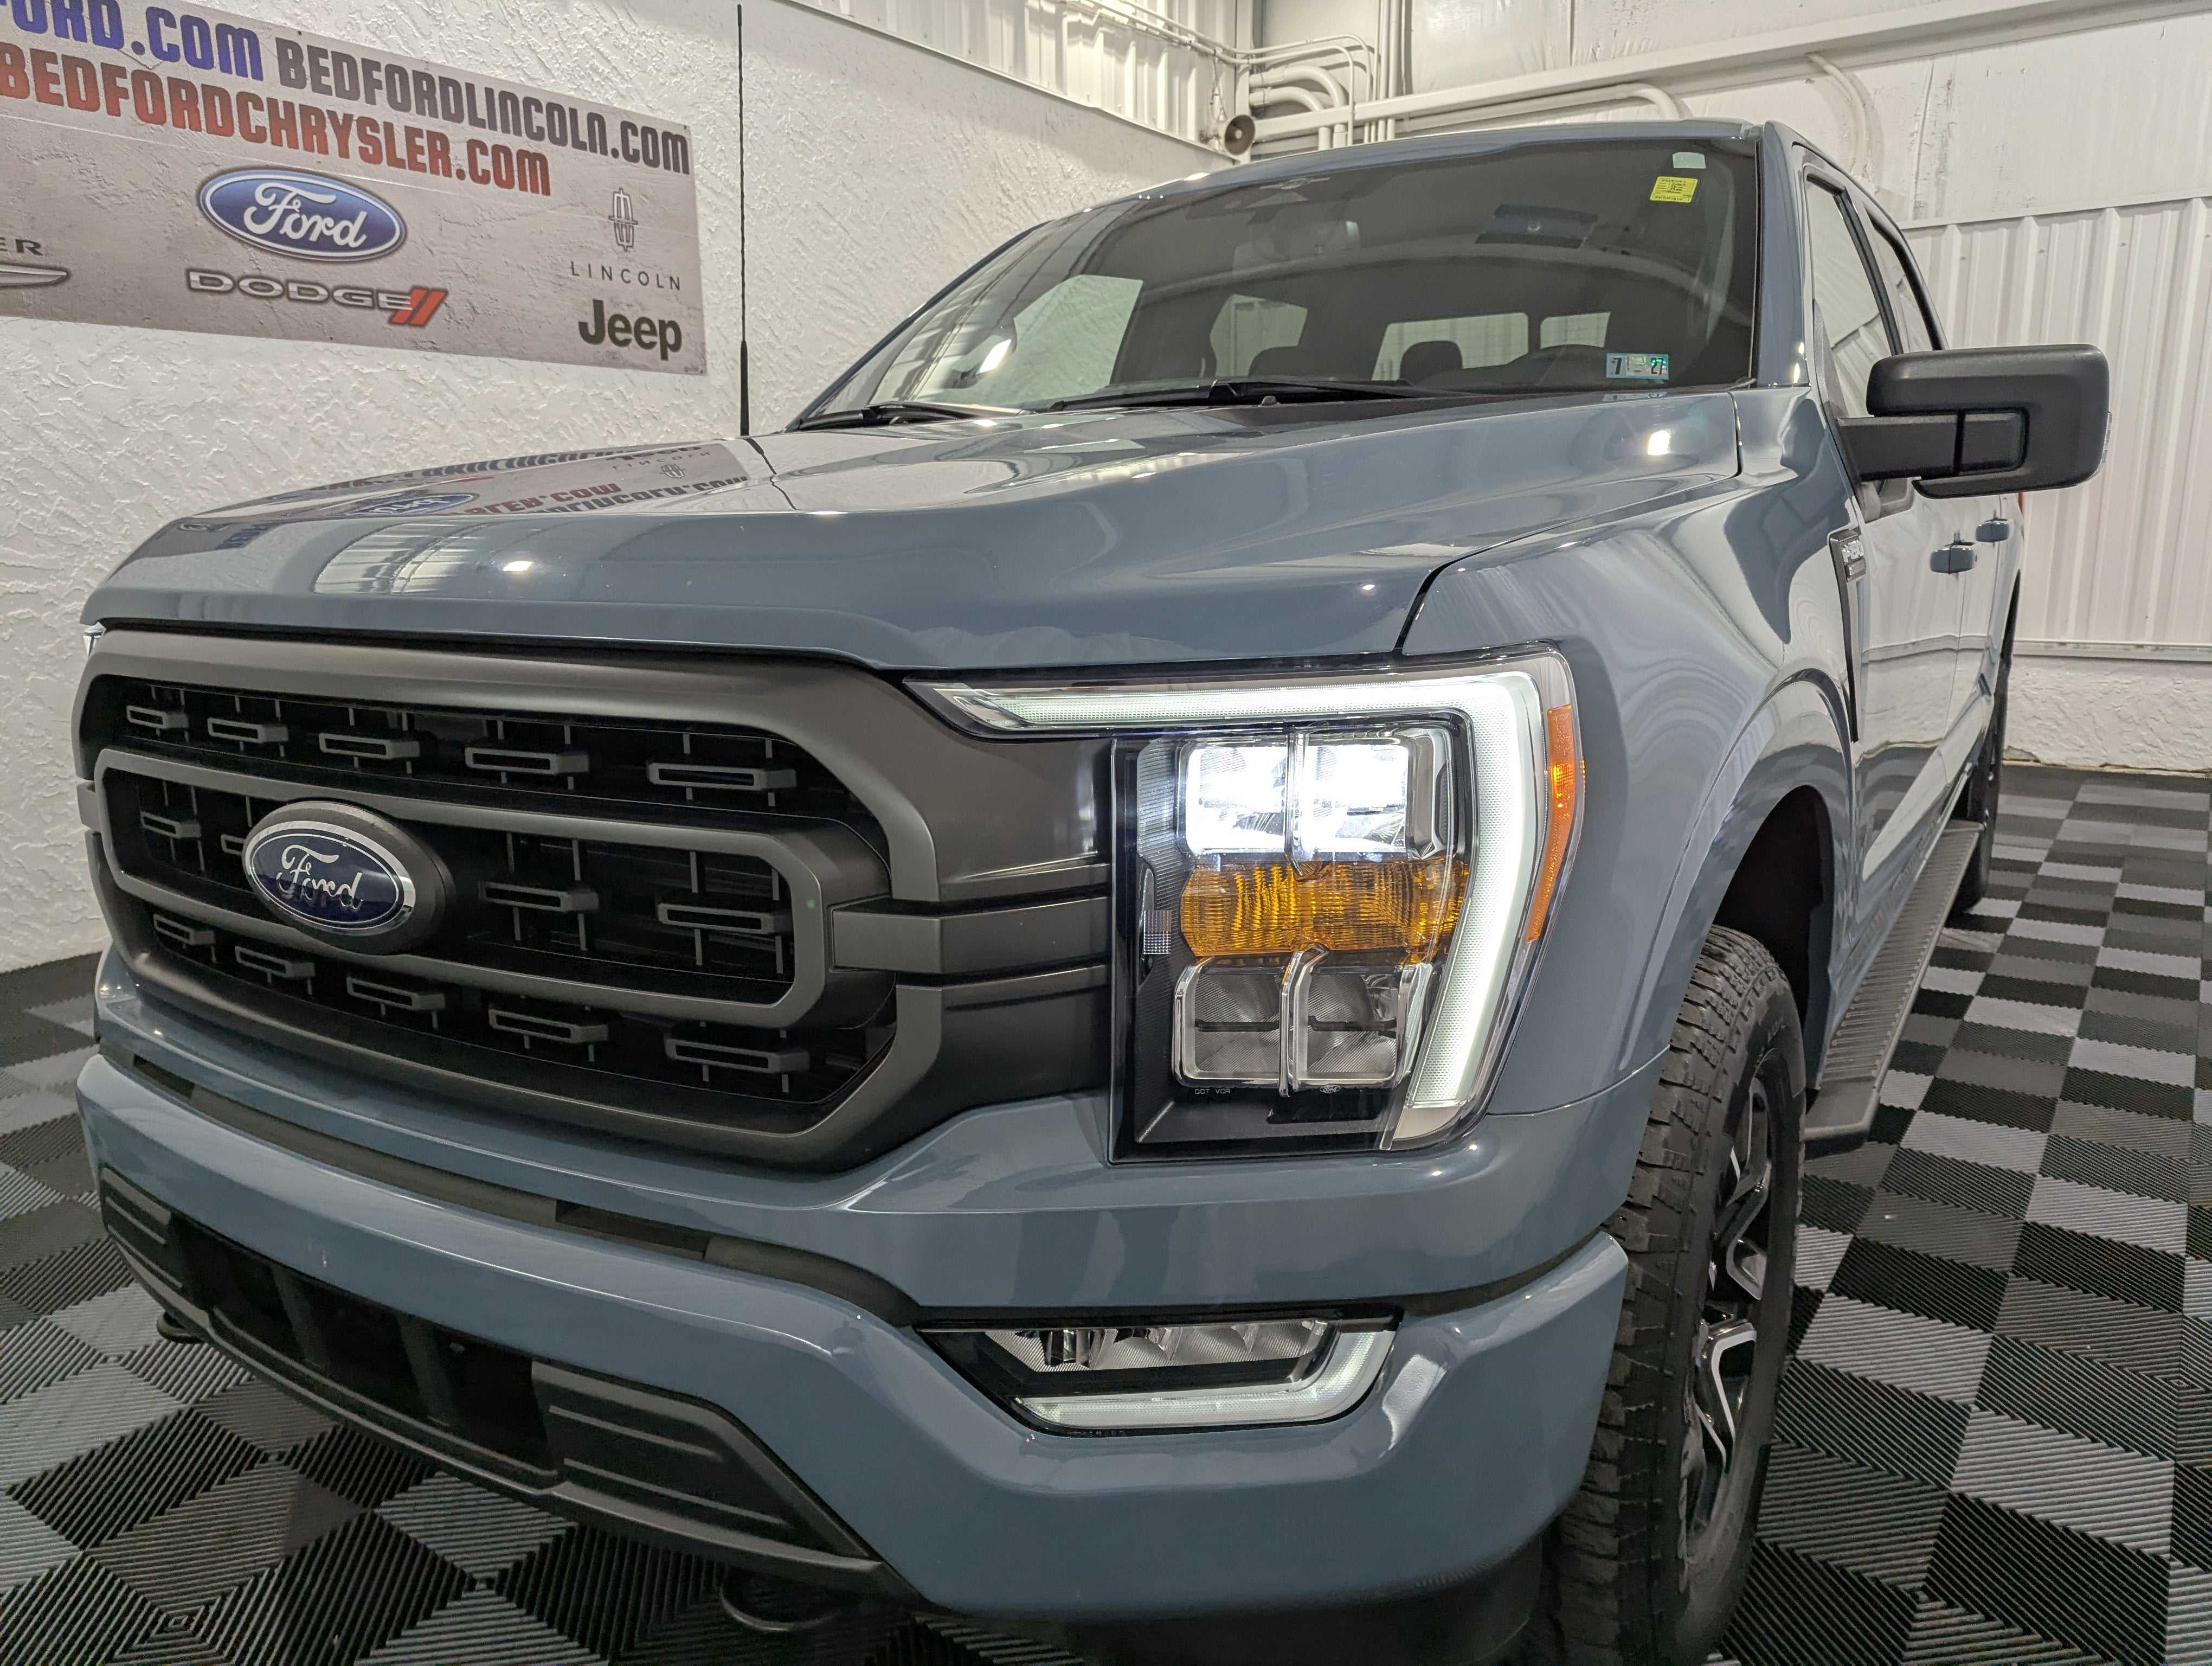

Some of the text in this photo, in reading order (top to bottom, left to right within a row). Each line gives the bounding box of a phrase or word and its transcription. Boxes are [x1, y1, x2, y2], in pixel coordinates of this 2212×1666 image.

[0, 0, 690, 175] ORD.COM BEDFORDLINCOLN.COM
[0, 41, 551, 196] BEDFORDCHRYSLER.COM
[243, 182, 368, 248] Ford
[188, 271, 414, 312] DODGE
[570, 261, 681, 291] LINCOLN
[577, 298, 683, 362] Jeep
[276, 844, 364, 912] Ford
